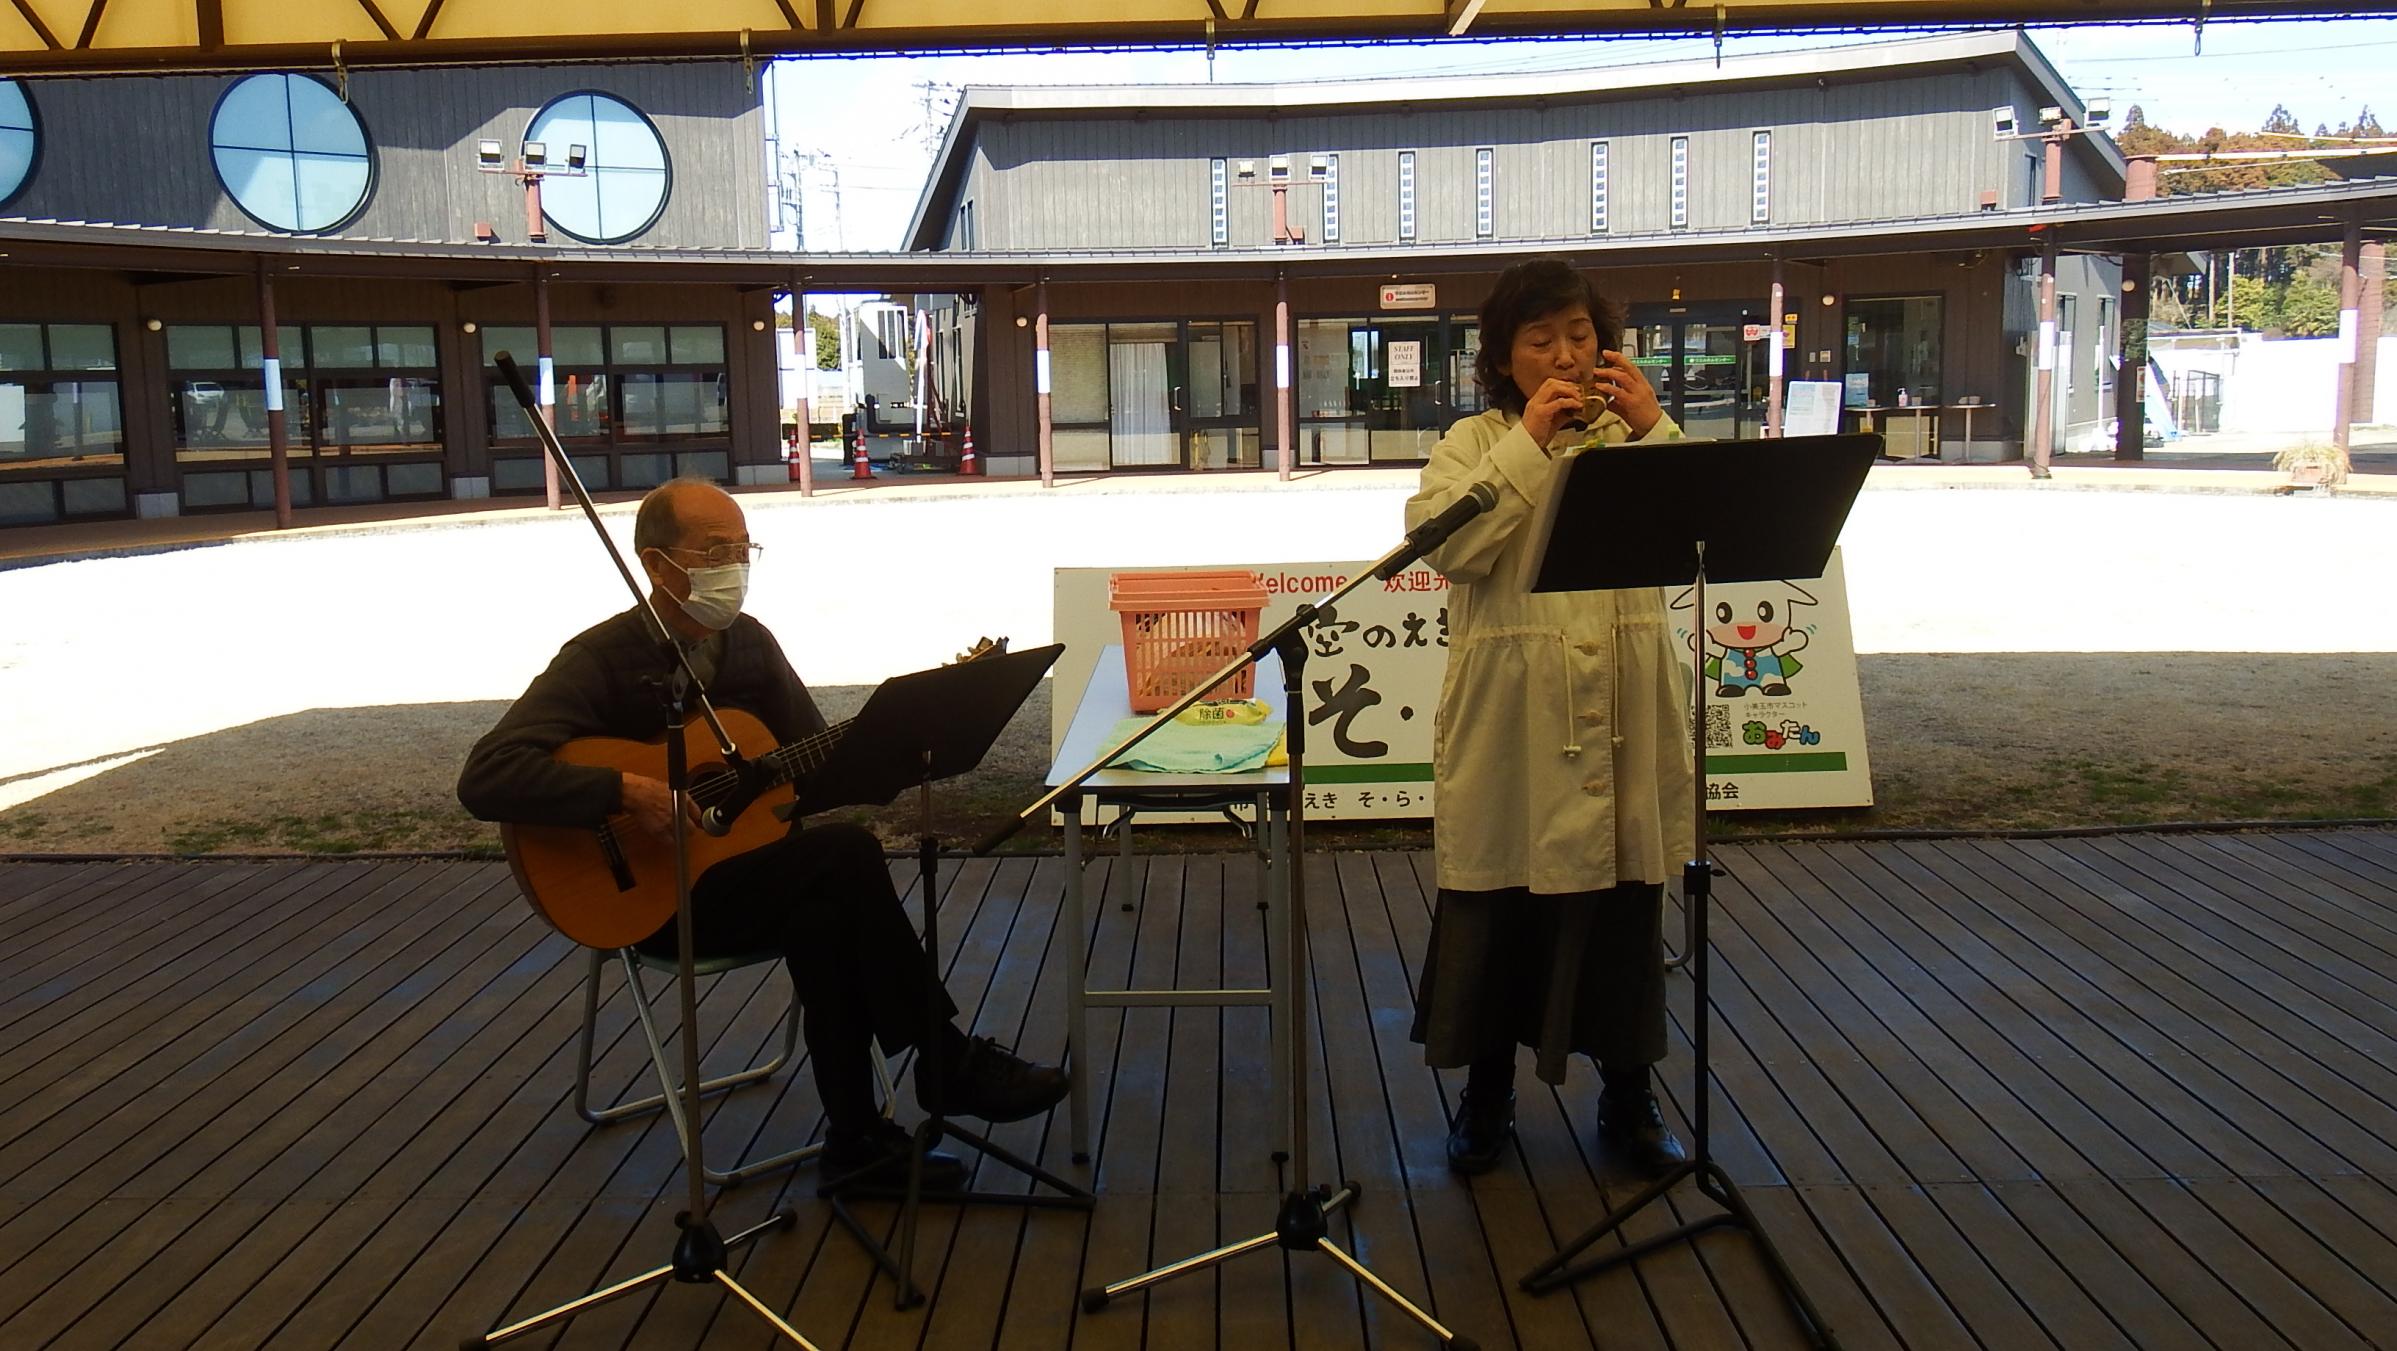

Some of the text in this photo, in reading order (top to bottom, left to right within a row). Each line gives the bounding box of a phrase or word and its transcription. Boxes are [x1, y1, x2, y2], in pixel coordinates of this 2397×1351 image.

[1200, 707, 1224, 720] 除菌
[1742, 719, 1820, 750] おみたん
